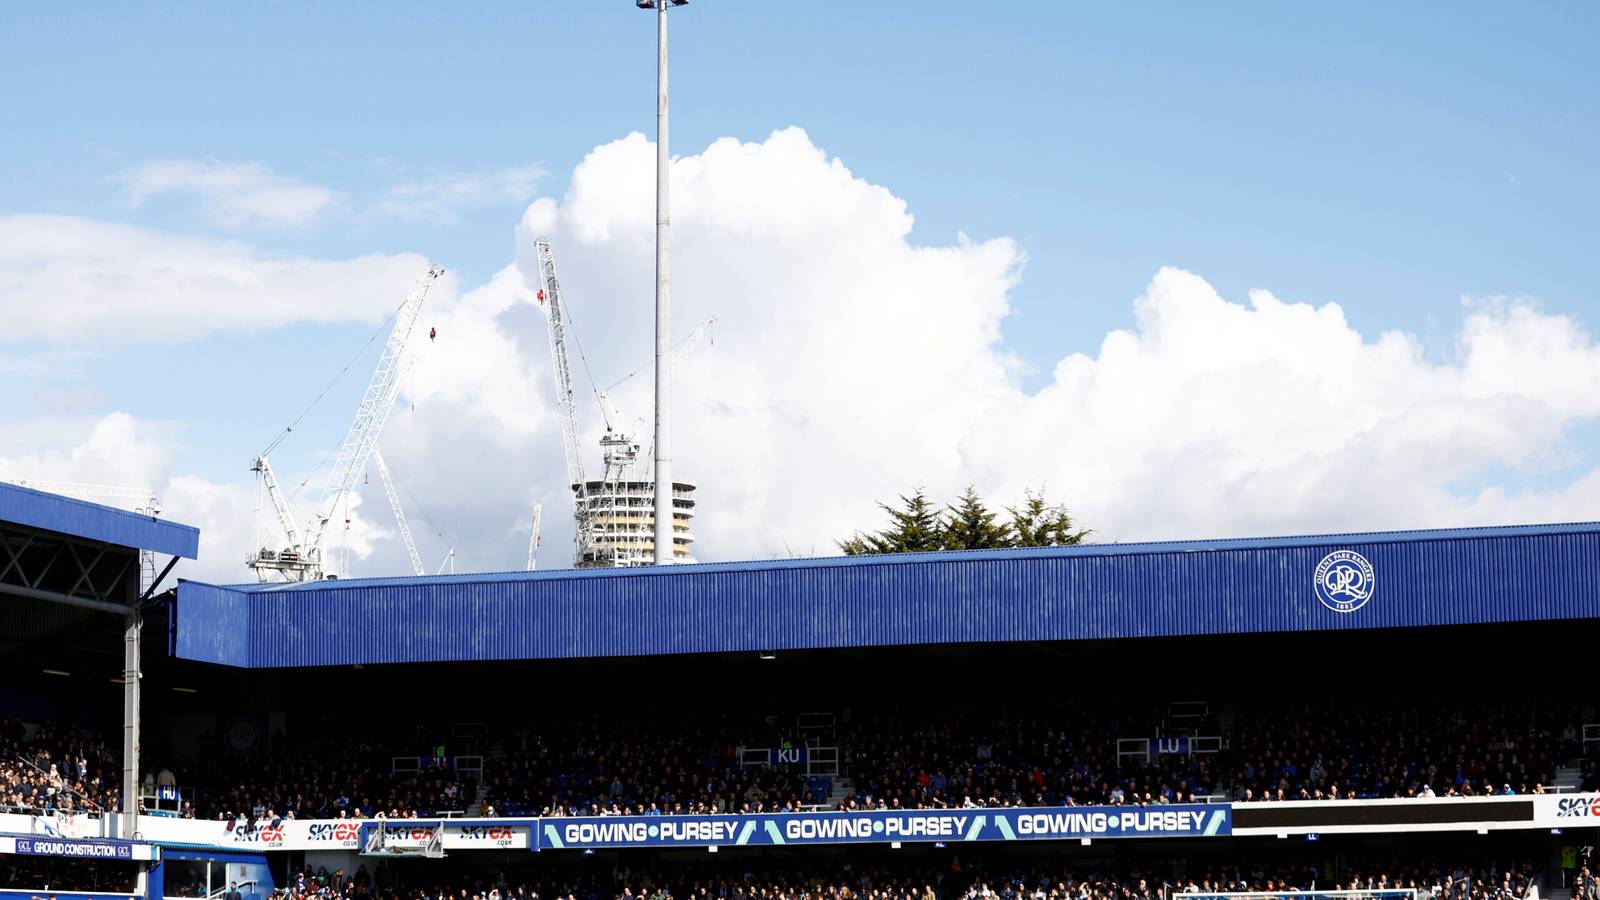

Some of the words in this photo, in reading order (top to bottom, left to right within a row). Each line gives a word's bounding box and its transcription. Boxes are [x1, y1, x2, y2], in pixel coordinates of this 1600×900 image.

[1317, 558, 1333, 584] QUEENS
[1352, 556, 1372, 583] RANGERS
[1159, 738, 1179, 753] LU
[778, 748, 800, 763] KU
[163, 784, 176, 800] HU
[786, 817, 871, 839] GOWING
[885, 816, 967, 836] PURSEY
[1018, 812, 1106, 834] GOWING
[1121, 810, 1206, 831] PURSEY
[565, 822, 647, 843] GOWING
[660, 821, 738, 841] PURSEY
[34, 842, 64, 854] GROUND
[65, 843, 116, 857] CONSTRUCTION
